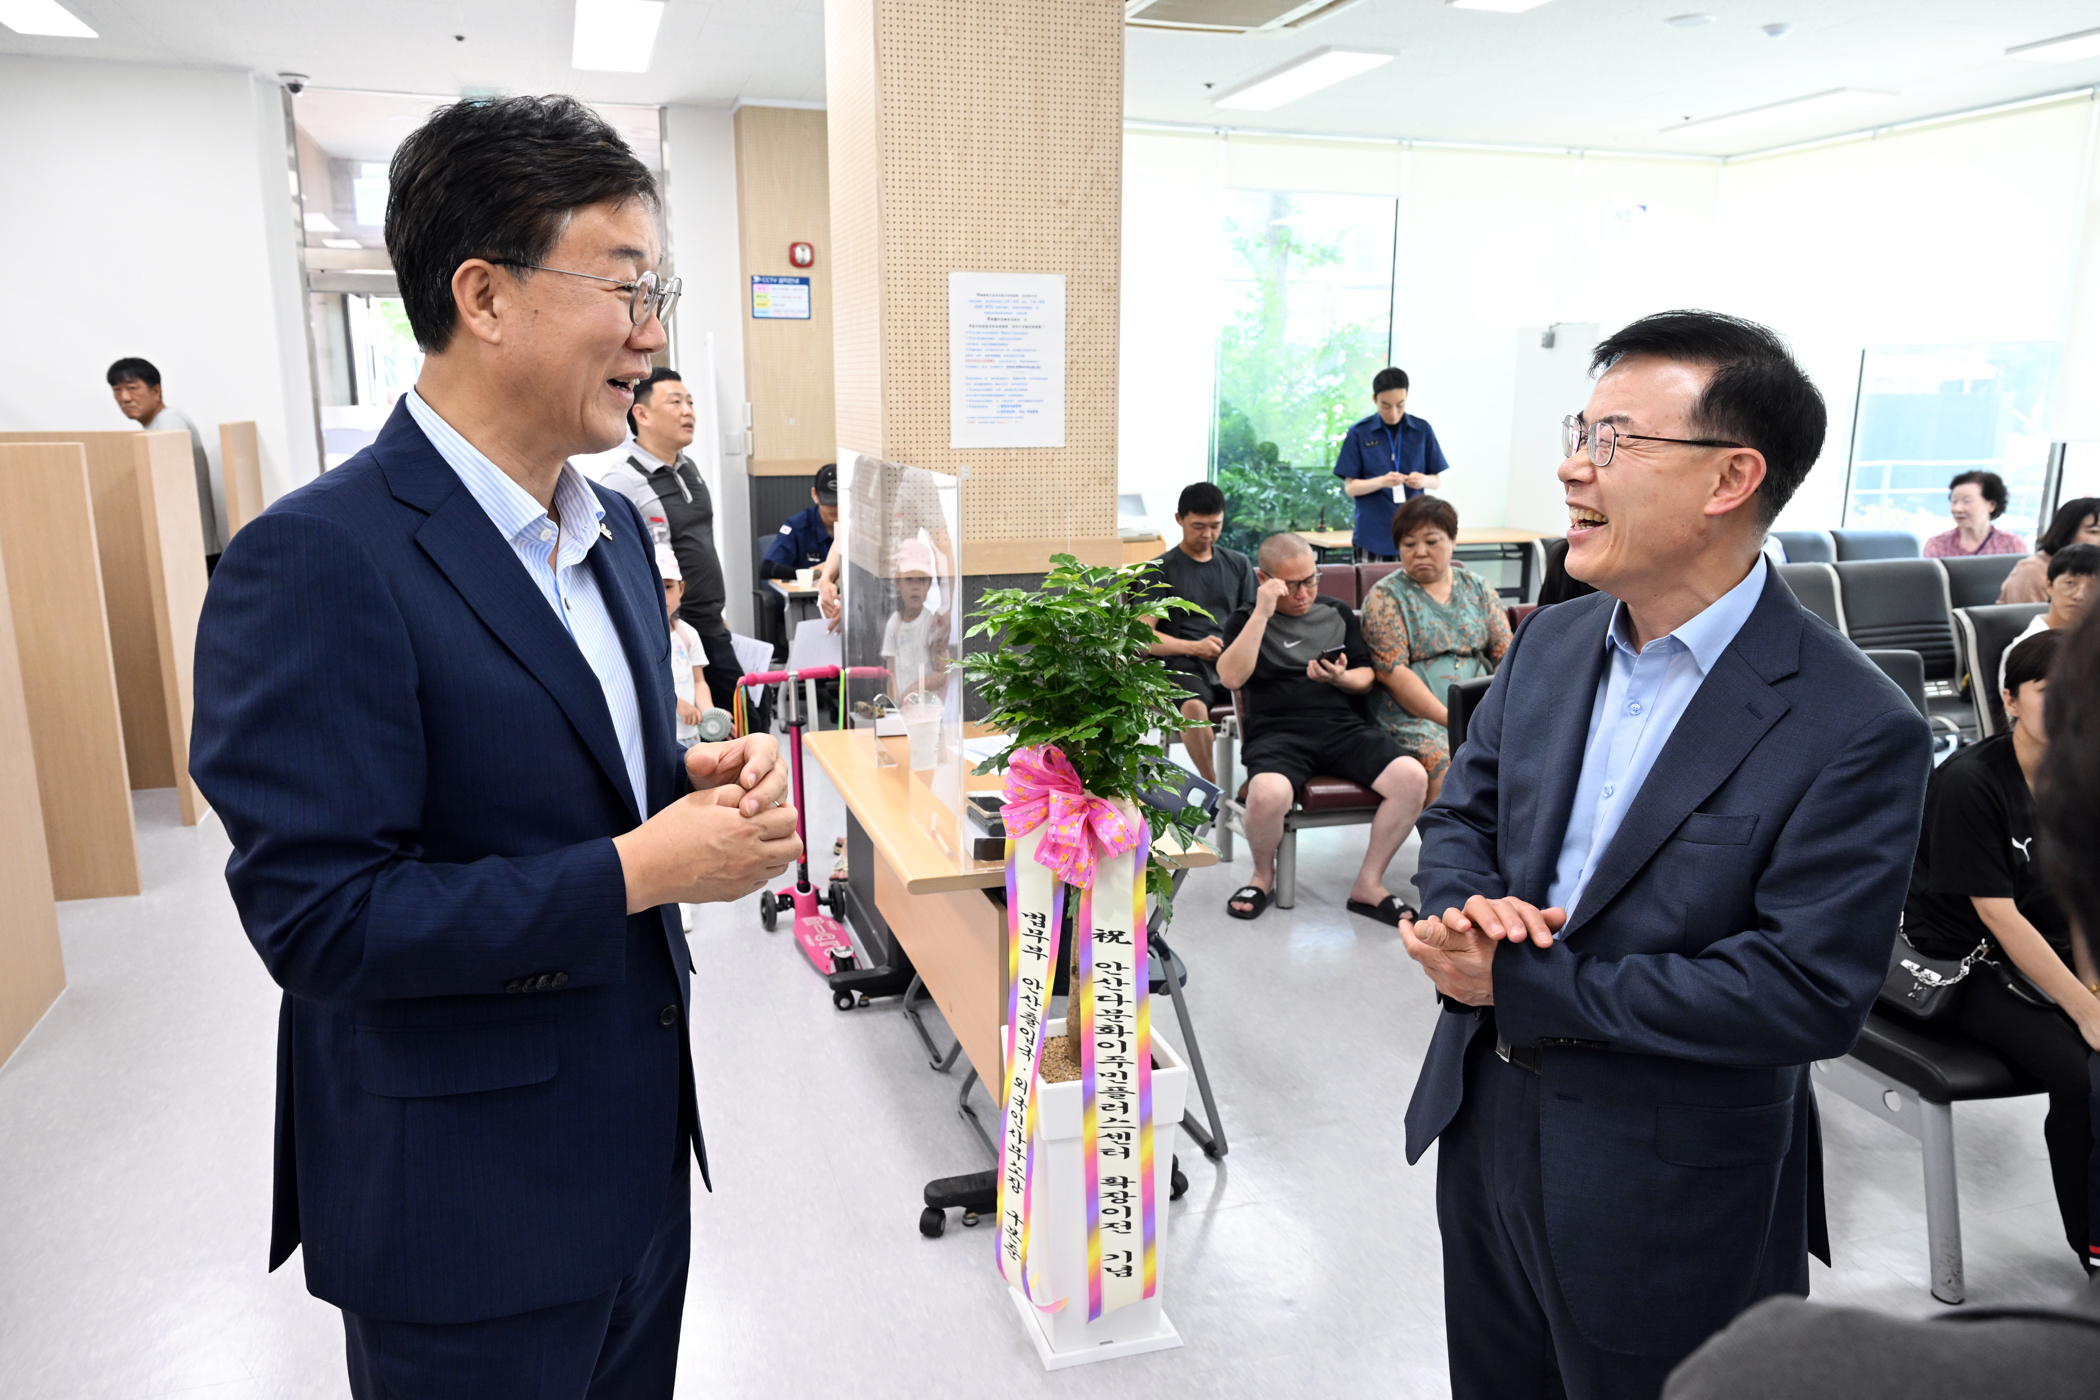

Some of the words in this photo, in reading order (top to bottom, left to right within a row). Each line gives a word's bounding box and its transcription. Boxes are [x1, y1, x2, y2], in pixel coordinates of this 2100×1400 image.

[1021, 912, 1049, 960] 법무부
[1091, 928, 1133, 945] 祝
[1092, 960, 1136, 1160] 안산다문화이주민플러스센터
[1099, 1175, 1137, 1235] 확장이전
[1102, 1250, 1133, 1278] 기념
